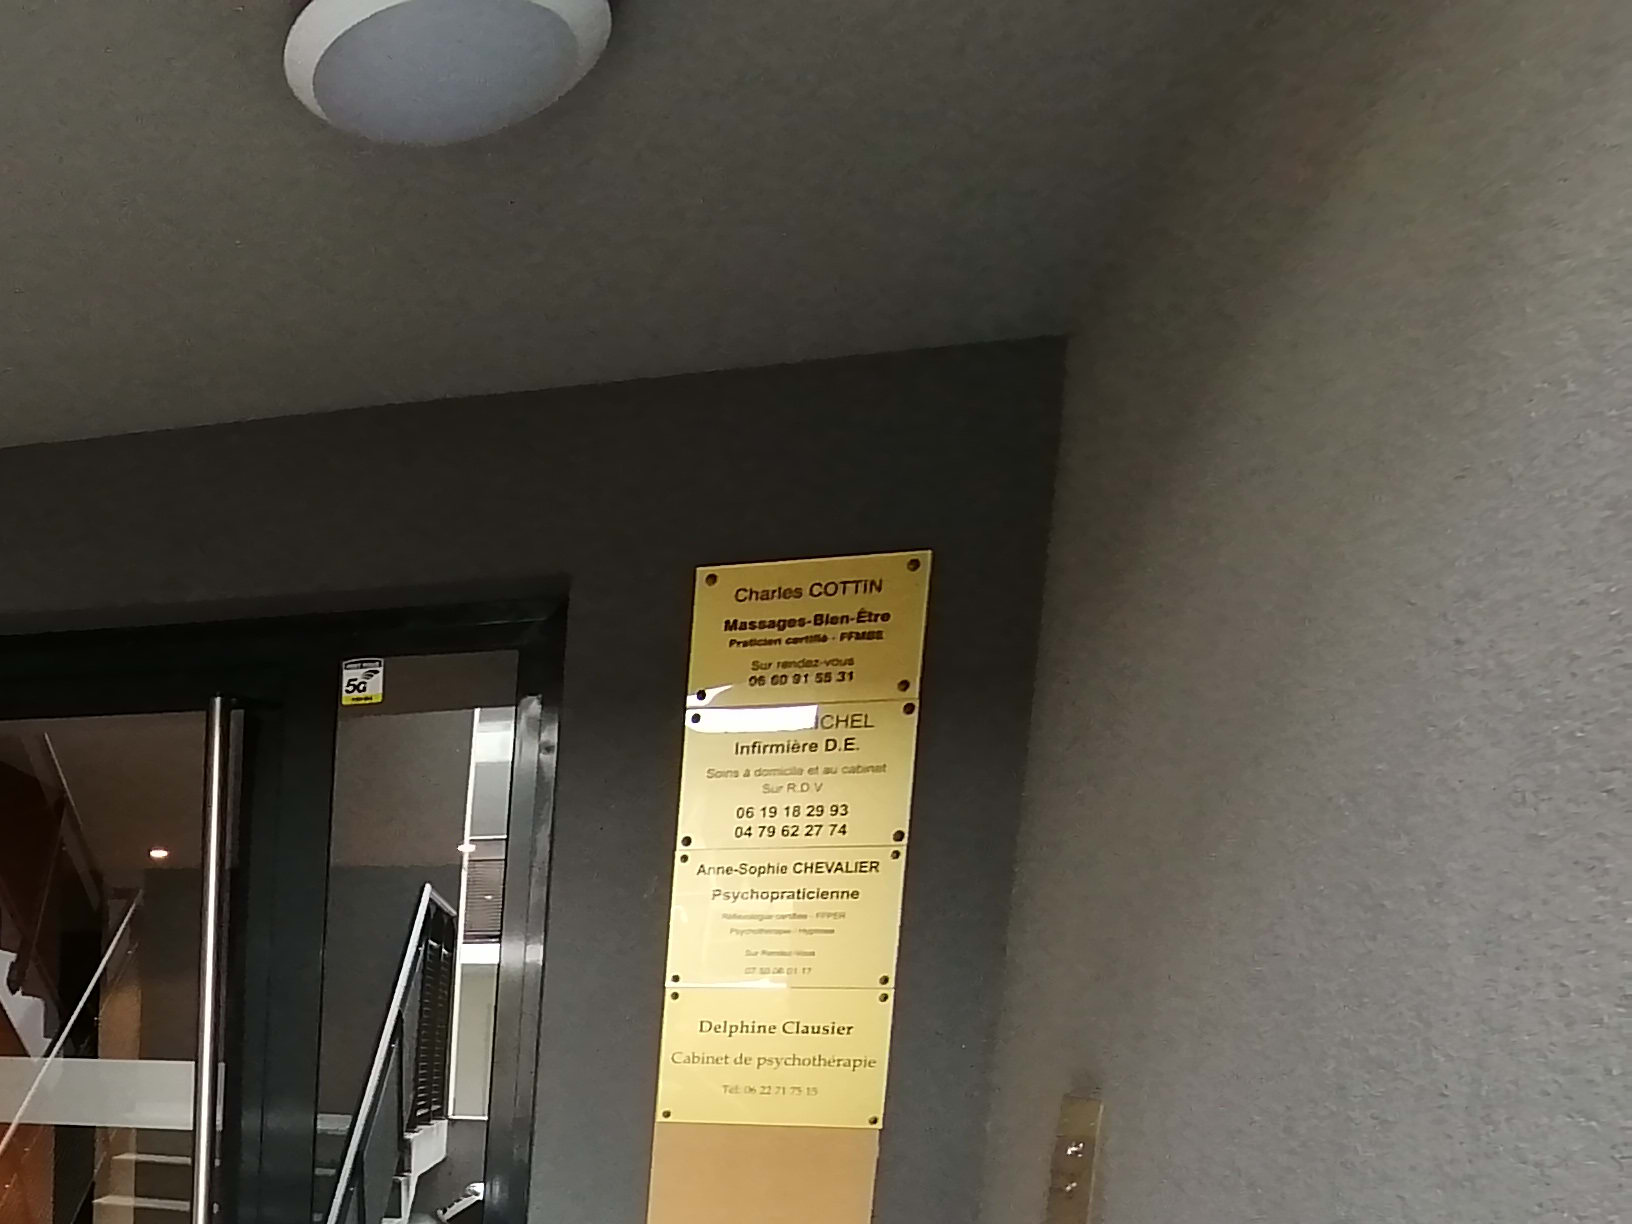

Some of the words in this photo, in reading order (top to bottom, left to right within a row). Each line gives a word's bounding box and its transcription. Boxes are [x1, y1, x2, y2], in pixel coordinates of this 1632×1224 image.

[734, 585, 803, 602] Charles
[808, 579, 883, 597] COTTIN
[723, 608, 891, 632] Massages-Bien-Être
[751, 659, 773, 671] Sur
[776, 656, 855, 670] rendez-vous
[748, 675, 766, 687] 06
[836, 671, 854, 683] 31
[734, 739, 819, 756] Infirmière
[825, 737, 860, 752] D.E.
[706, 768, 739, 779] Soins
[754, 764, 803, 777] domicile
[807, 764, 820, 776] et
[822, 765, 838, 775] au
[841, 762, 888, 774] cabinet
[762, 783, 784, 795] Sur
[736, 806, 755, 819] 06
[759, 806, 778, 818] 19
[784, 805, 801, 818] 18
[806, 805, 825, 818] 29
[829, 804, 849, 817] 93
[734, 826, 753, 839] 04
[758, 825, 776, 838] 79
[781, 825, 800, 838] 62
[804, 824, 823, 837] 27
[828, 823, 848, 836] 74
[696, 862, 788, 877] Anne-Sophie
[792, 860, 880, 875] CHEVALIER
[711, 887, 860, 903] Psychopraticienne
[698, 1020, 777, 1038] Delphine
[781, 1020, 854, 1036] Clausier
[671, 1052, 730, 1066] Cabinet
[733, 1052, 753, 1066] de
[756, 1053, 878, 1072] psychothérapie
[759, 1085, 772, 1096] 22
